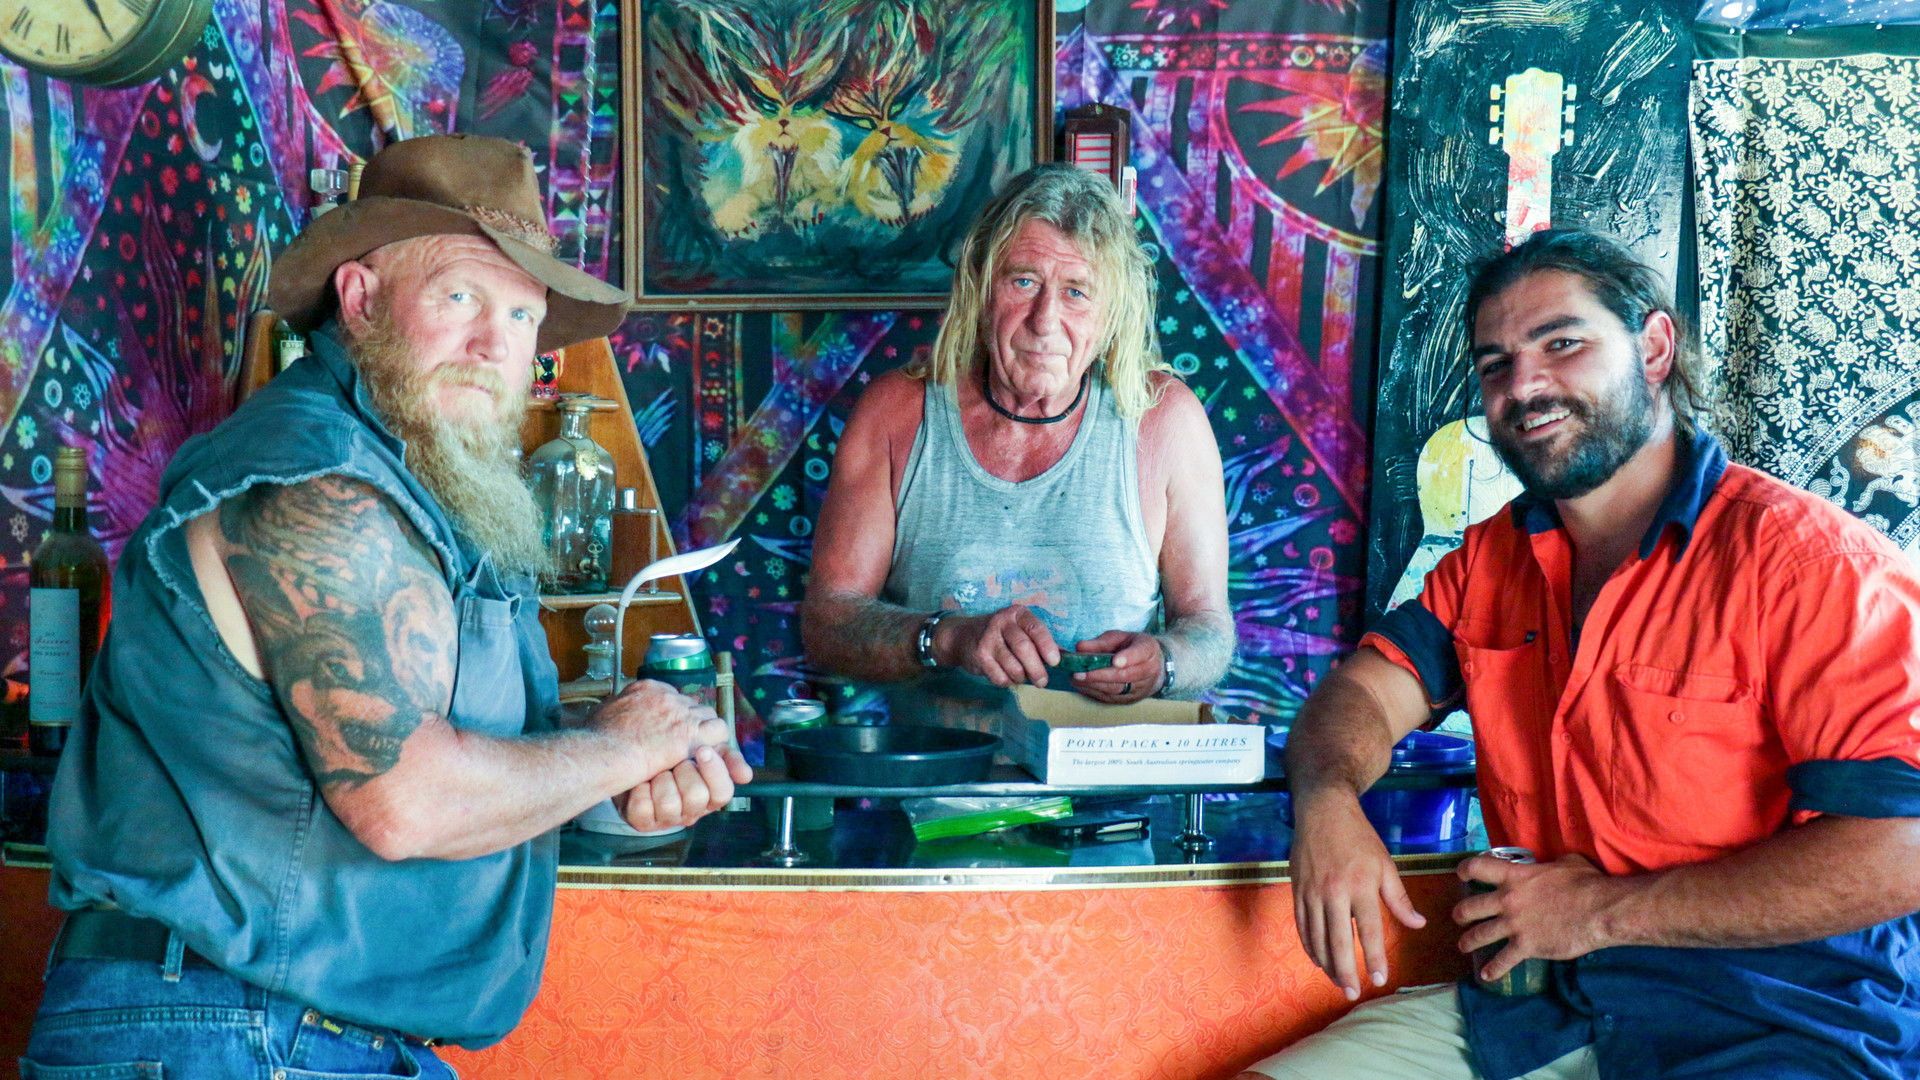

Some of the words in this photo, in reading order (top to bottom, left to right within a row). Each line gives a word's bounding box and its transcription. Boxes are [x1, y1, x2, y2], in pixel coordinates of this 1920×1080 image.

[1067, 739, 1113, 748] PORTA
[1121, 739, 1159, 748] PACK
[1177, 739, 1190, 748] 10
[1196, 737, 1248, 747] LITRES
[1084, 758, 1106, 766] largest
[1215, 758, 1241, 766] company
